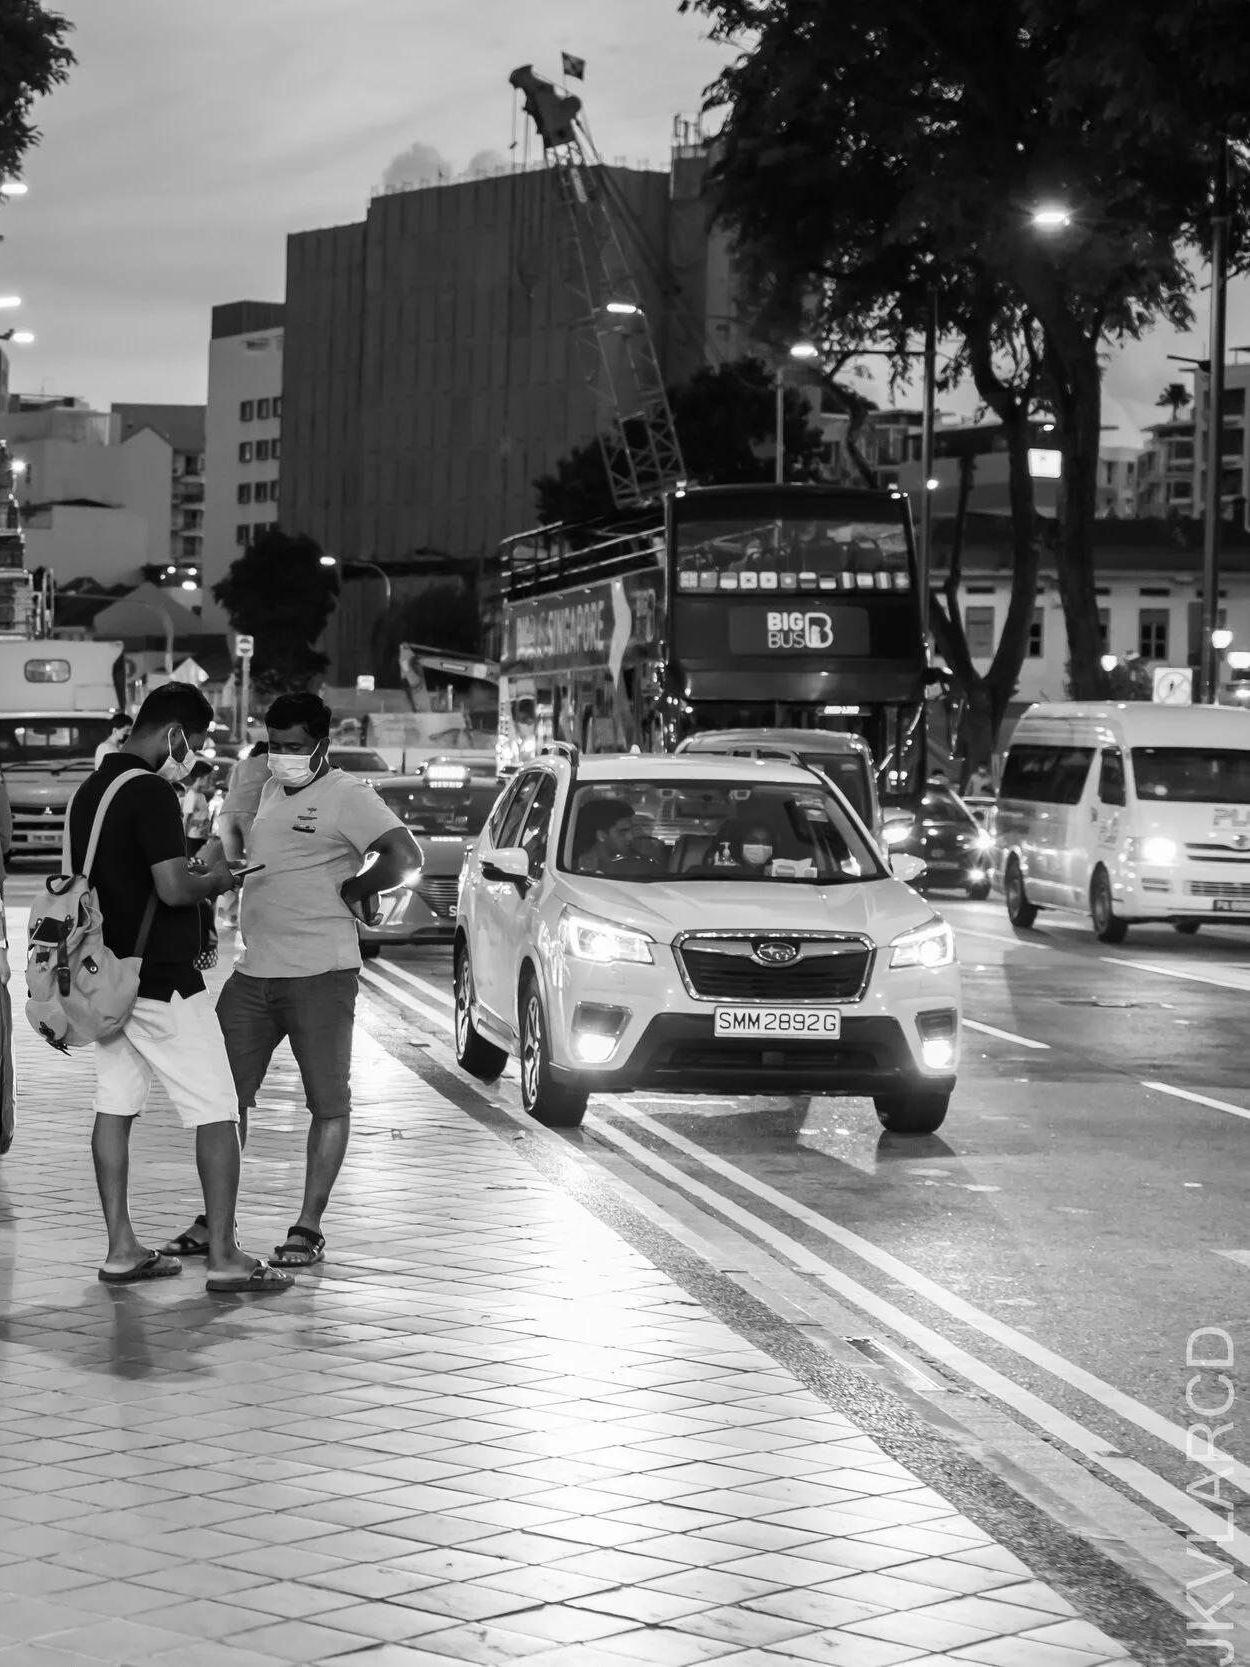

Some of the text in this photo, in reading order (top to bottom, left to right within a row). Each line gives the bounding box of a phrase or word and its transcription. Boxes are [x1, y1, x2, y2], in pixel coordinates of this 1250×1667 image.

[767, 612, 804, 631] BIG
[768, 631, 805, 649] BUS
[719, 1012, 837, 1032] SMM2892G
